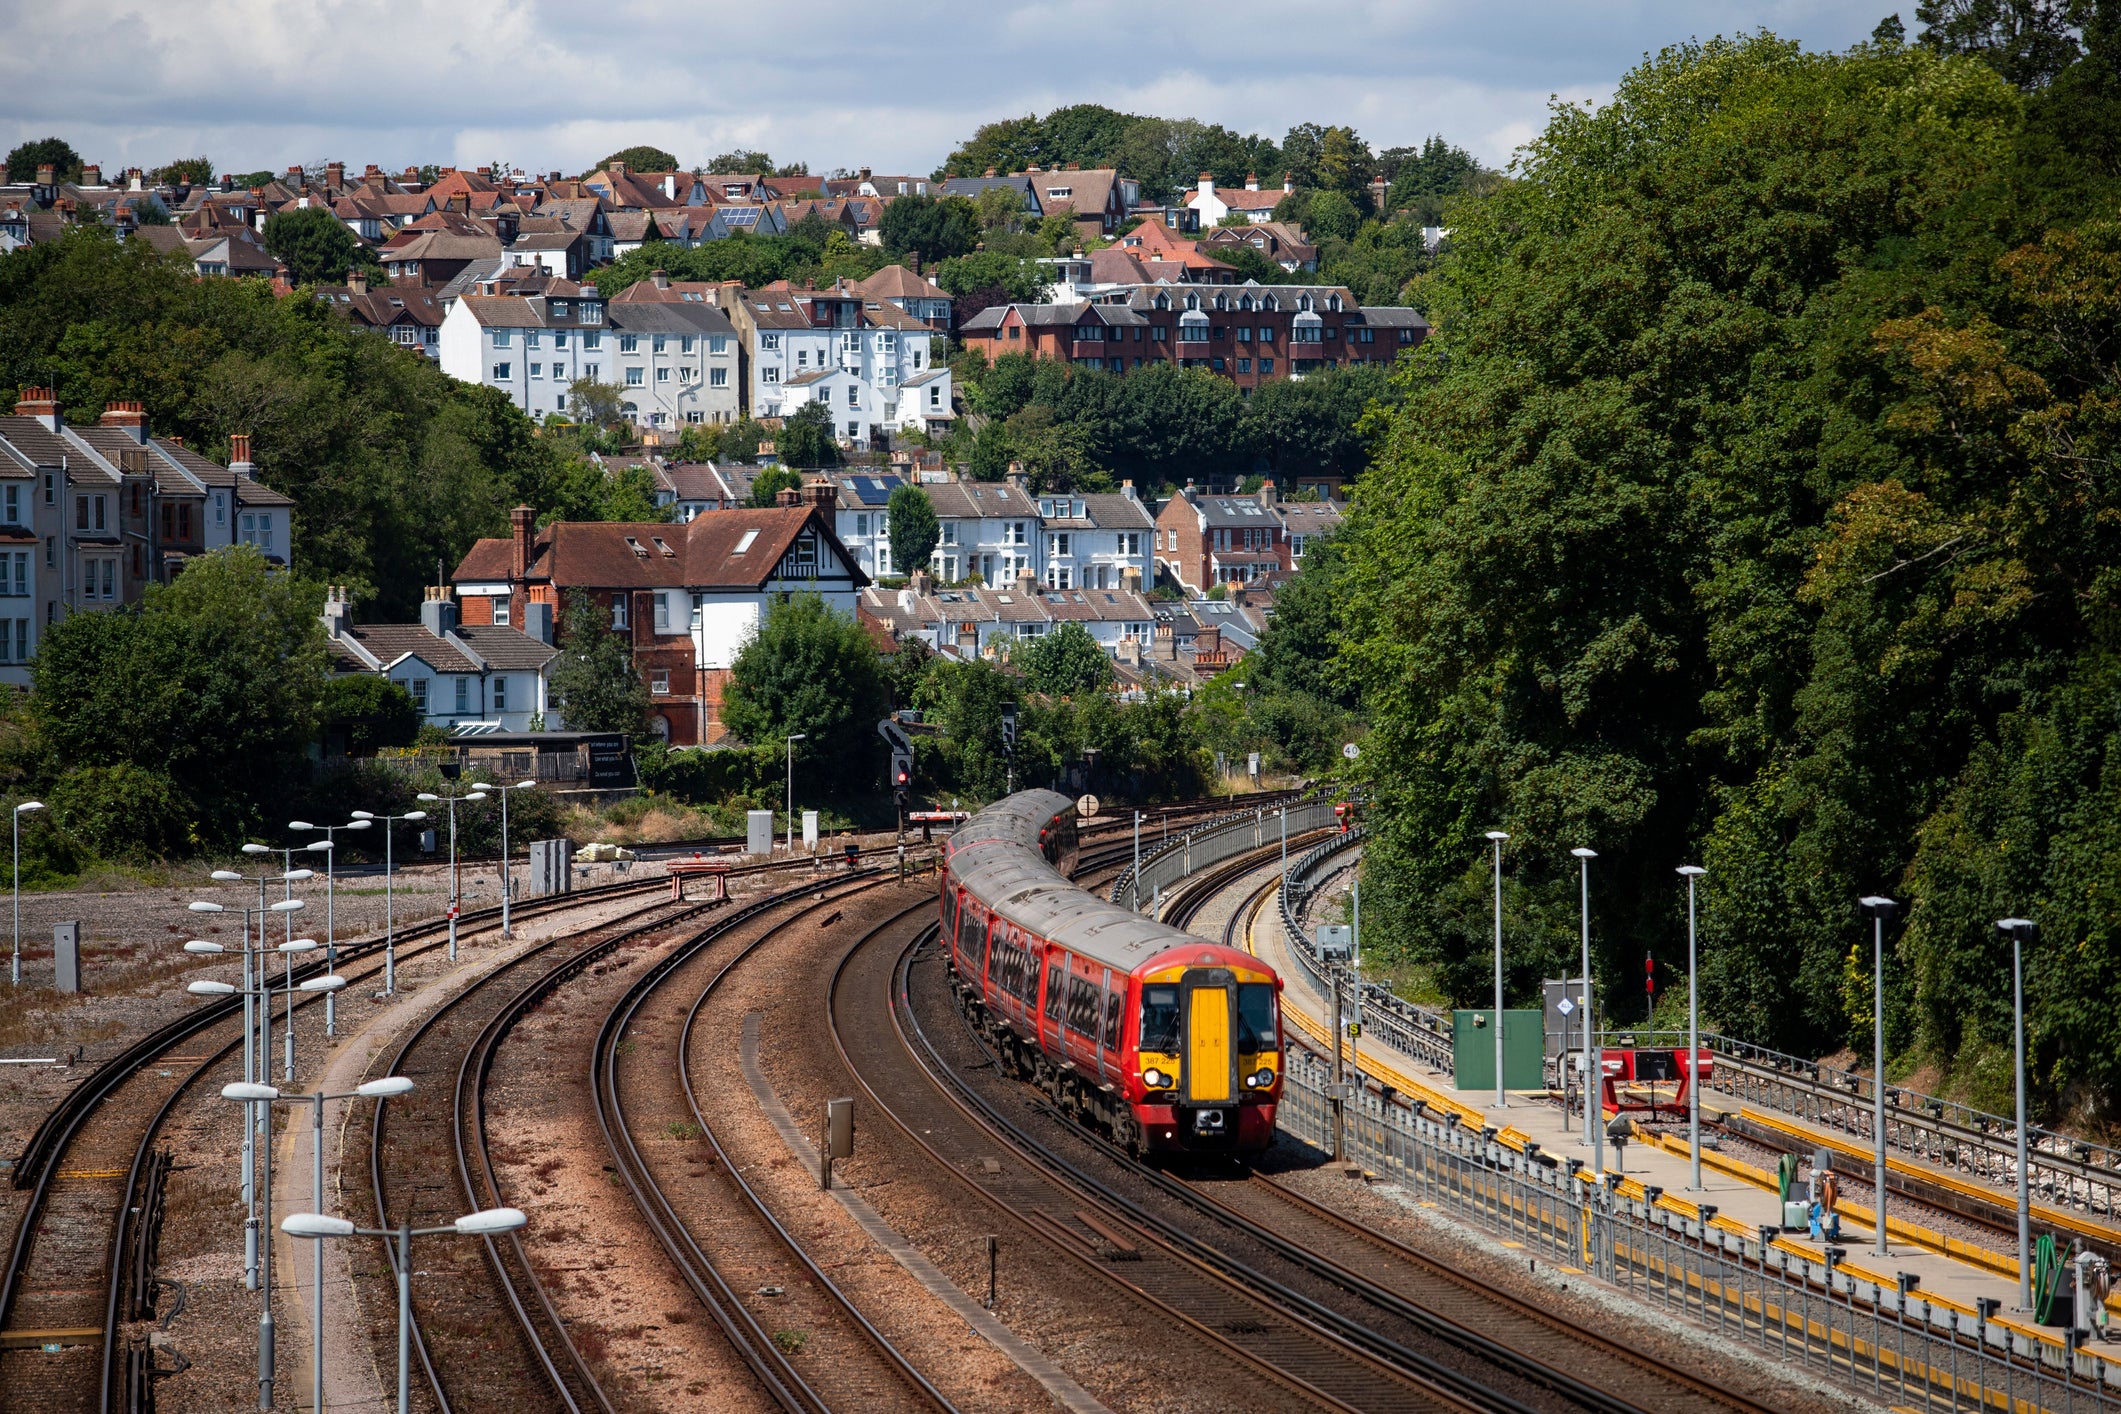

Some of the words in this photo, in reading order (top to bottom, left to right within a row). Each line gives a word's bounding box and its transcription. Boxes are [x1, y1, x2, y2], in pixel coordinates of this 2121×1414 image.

[1344, 746, 1358, 755] 40
[1350, 1024, 1359, 1035] S
[1145, 1057, 1159, 1065] 387
[1243, 1058, 1257, 1066] 387
